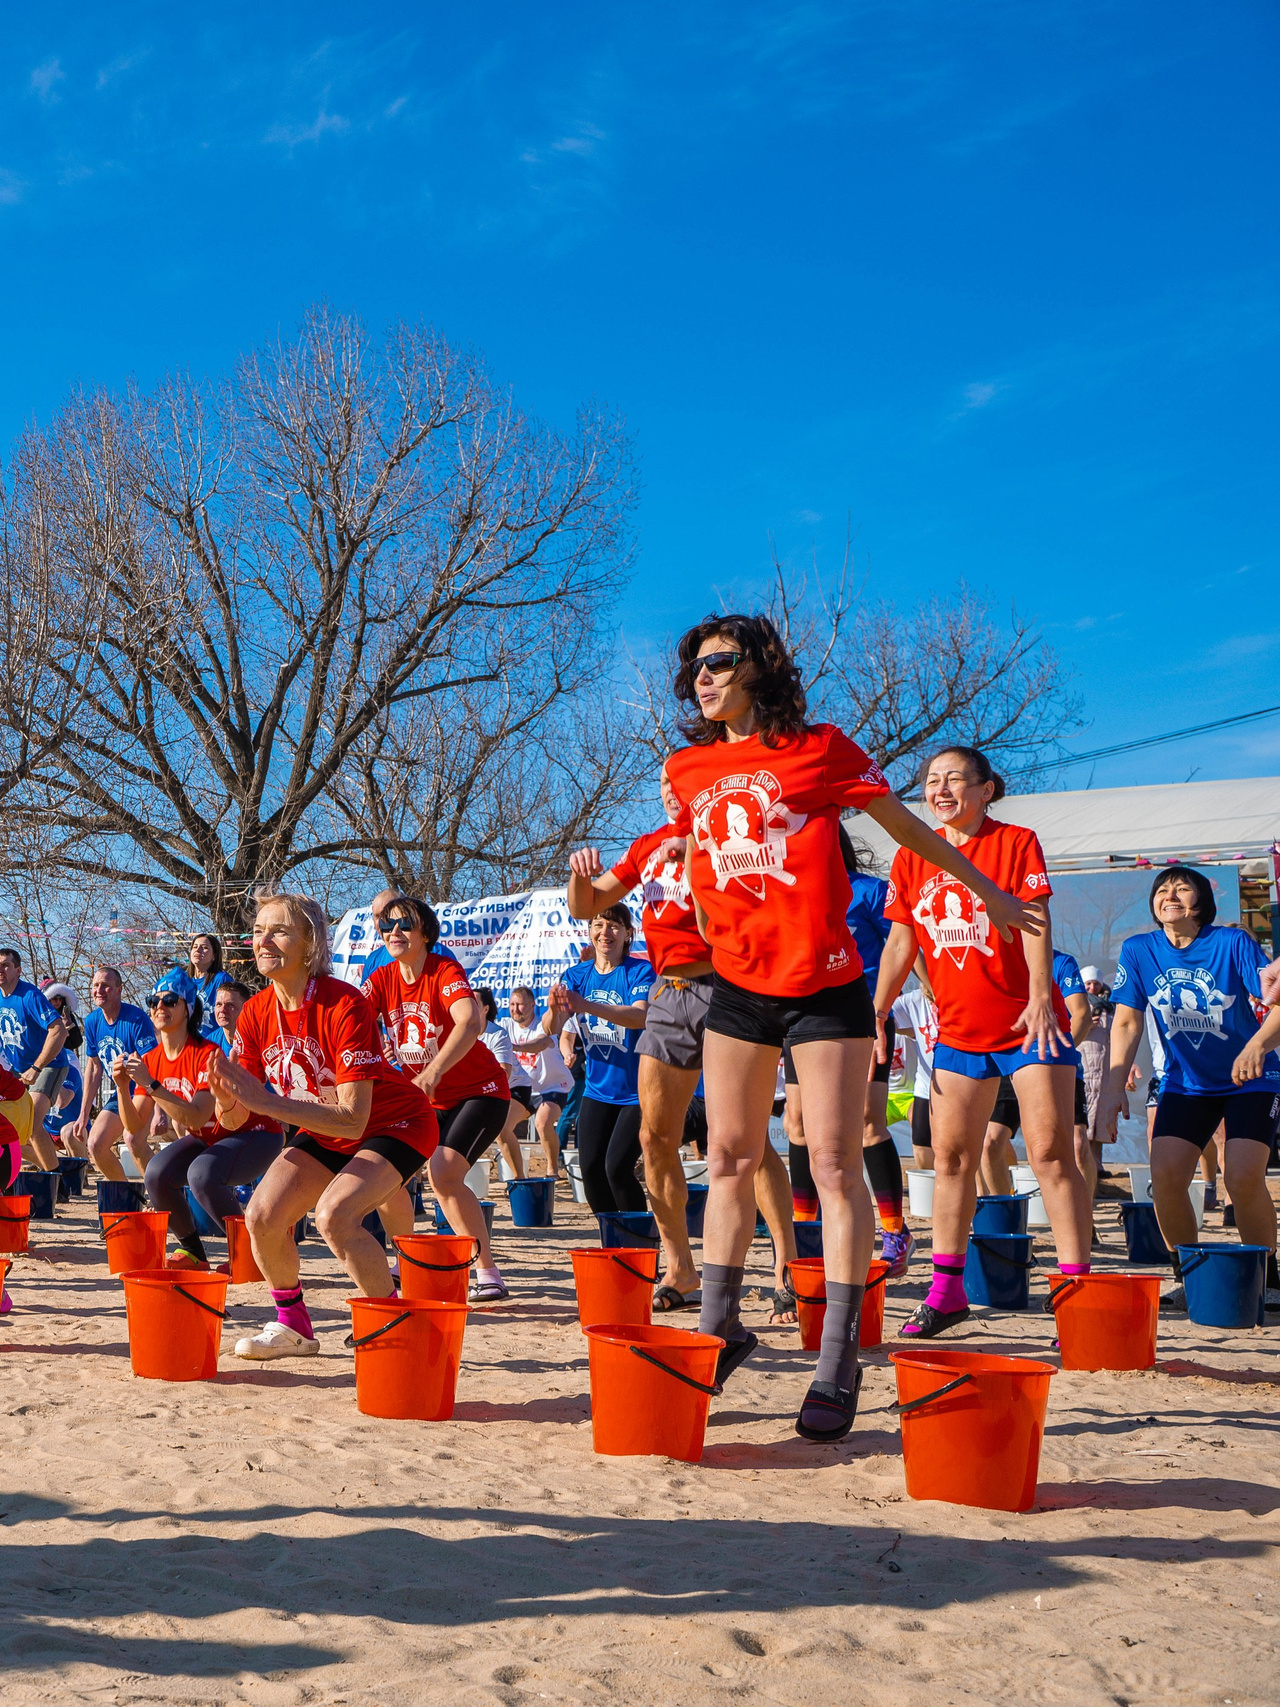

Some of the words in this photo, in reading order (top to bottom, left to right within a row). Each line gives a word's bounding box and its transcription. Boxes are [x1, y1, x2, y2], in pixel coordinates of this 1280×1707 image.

[721, 776, 748, 790] СЛАВА
[755, 771, 778, 792] ДОЛГ
[441, 938, 484, 948] ПОБЕДЫ
